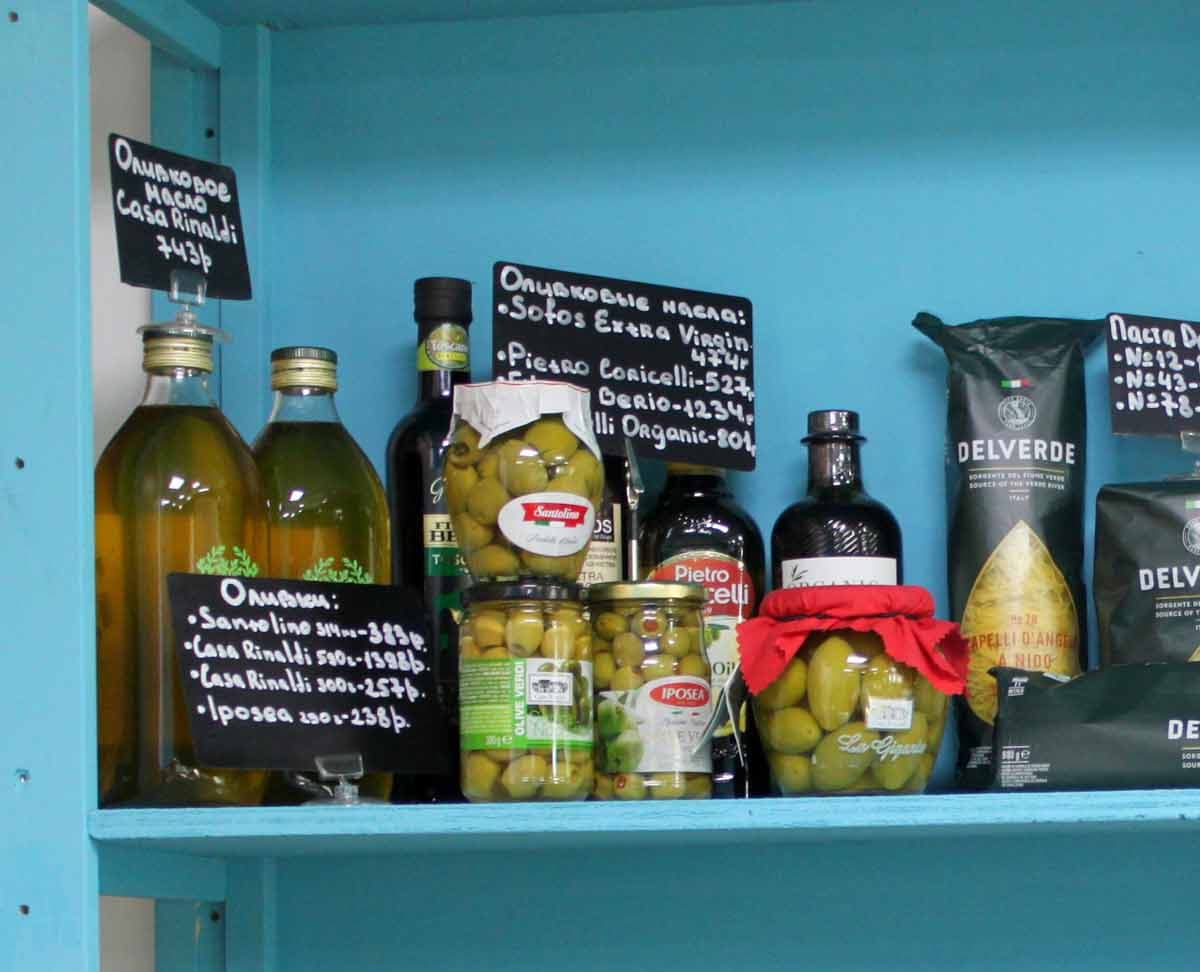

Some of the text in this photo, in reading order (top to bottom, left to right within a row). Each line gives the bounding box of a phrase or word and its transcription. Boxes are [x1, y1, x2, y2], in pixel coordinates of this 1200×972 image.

[115, 138, 231, 202] Оливковое
[116, 188, 237, 244] Casa Rinaldi
[501, 265, 649, 311] Оливковые
[509, 295, 586, 329] Sofos
[594, 309, 671, 341] Extra
[1110, 315, 1176, 347] Паста
[508, 341, 589, 376] Pietro
[958, 440, 1075, 464] DELVERDE
[533, 505, 580, 519] Santolino
[675, 566, 730, 582] Pietro
[199, 606, 311, 636] Santolino
[193, 635, 239, 659] Casa
[243, 639, 312, 666] Rinaldi
[200, 663, 246, 690] Casa
[246, 668, 312, 693] Rinaldi
[661, 687, 704, 700] IPOSEA
[207, 695, 293, 726] Iposea
